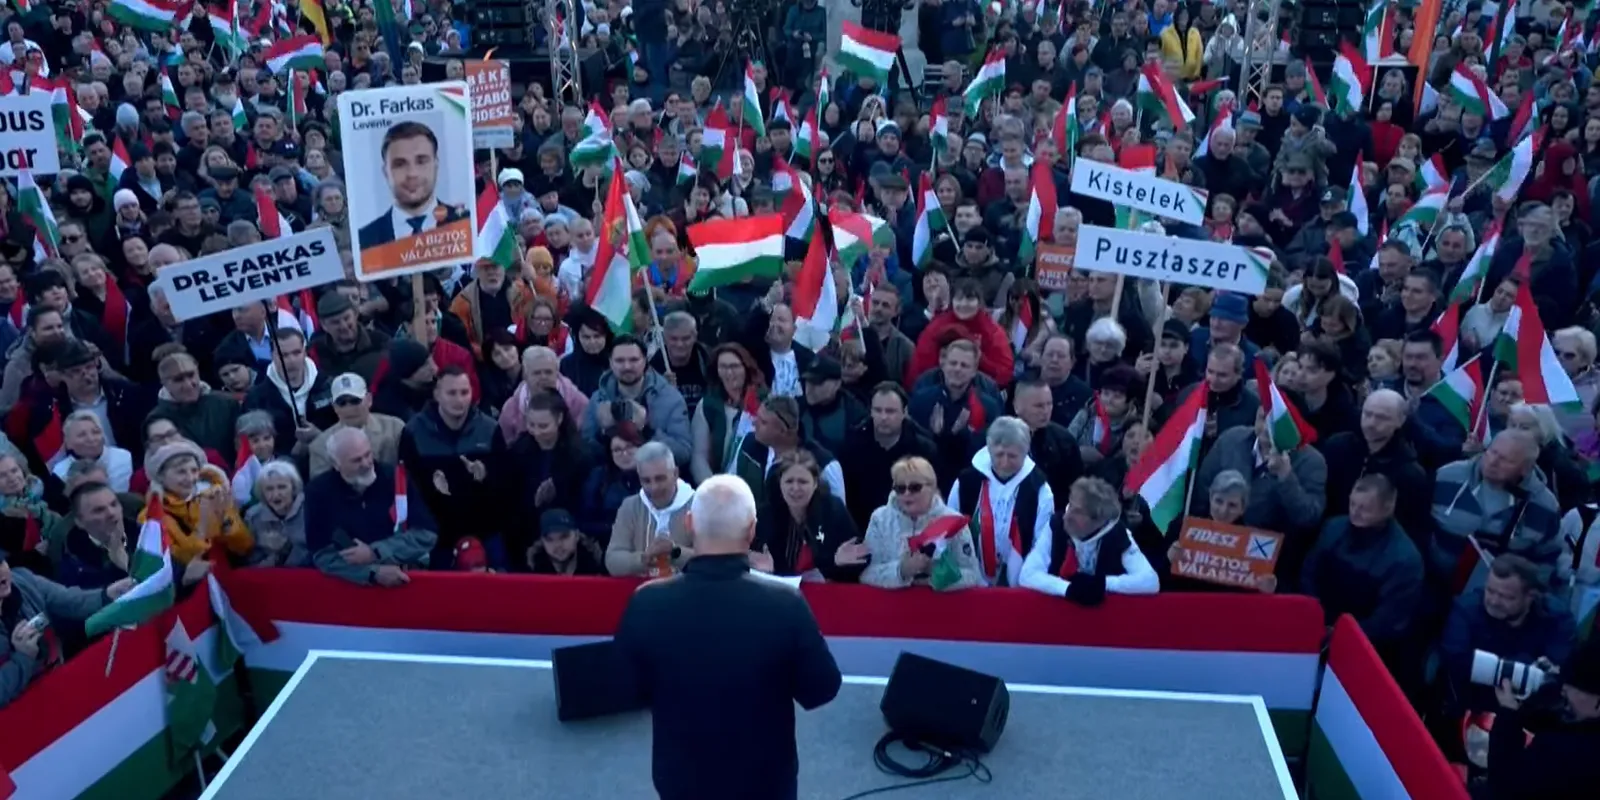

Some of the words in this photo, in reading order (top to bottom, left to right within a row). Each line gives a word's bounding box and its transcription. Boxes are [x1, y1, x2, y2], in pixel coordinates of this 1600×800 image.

[467, 69, 508, 86] BÉKE
[351, 101, 375, 117] Dr.
[380, 96, 434, 114] Farkas
[353, 119, 392, 130] Levente
[1088, 170, 1185, 213] Kistelek
[415, 237, 424, 248] A
[426, 229, 467, 245] BIZTOS
[400, 242, 468, 263] VÁLASZTÁS
[1095, 238, 1247, 281] Pusztaszer
[172, 270, 219, 291] DR.
[223, 240, 326, 278] FARKAS
[199, 261, 311, 302] LEVENTE
[1186, 527, 1242, 548] FIDESZ
[1194, 550, 1249, 571] BIZTOS
